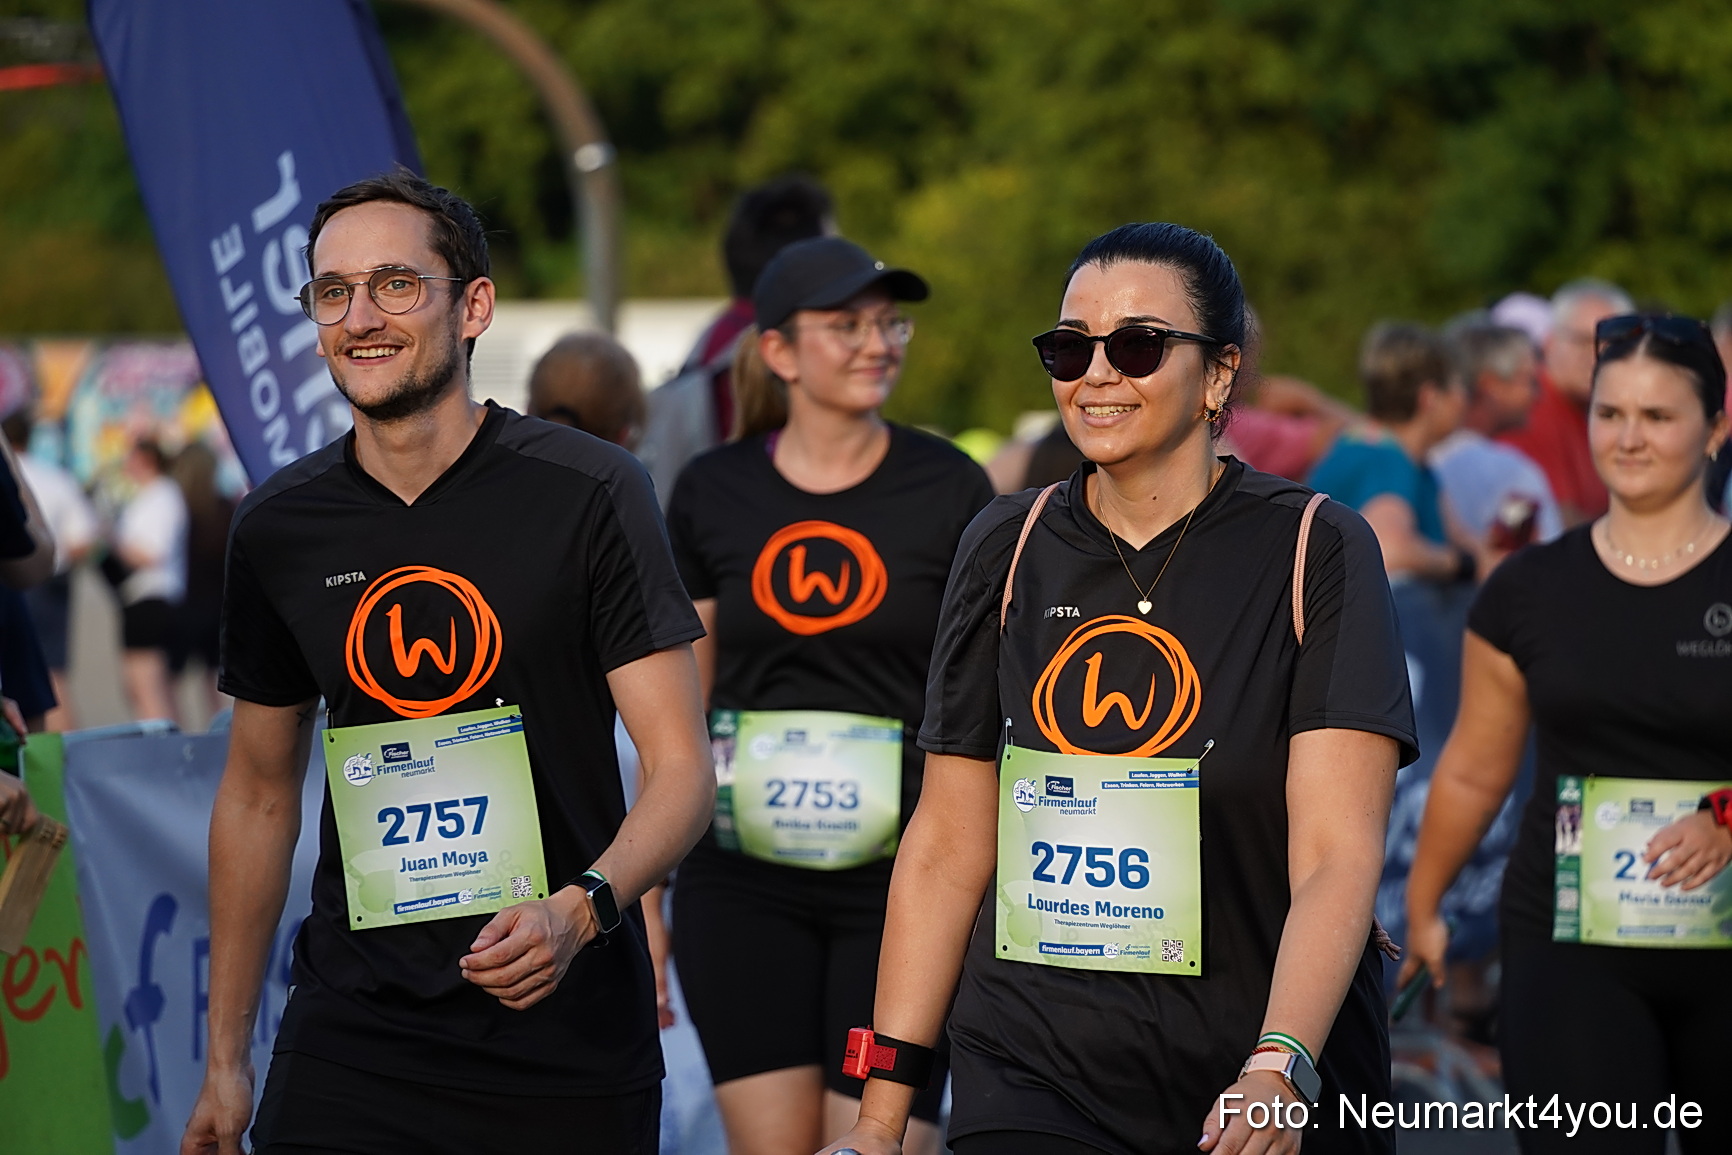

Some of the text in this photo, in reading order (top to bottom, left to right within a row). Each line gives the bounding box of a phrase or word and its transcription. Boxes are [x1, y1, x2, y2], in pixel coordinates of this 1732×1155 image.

[325, 571, 367, 588] KIPSTA
[1043, 606, 1081, 620] KIPSTA
[377, 756, 434, 775] Firmenlauf
[401, 766, 435, 778] neumarkt
[766, 779, 859, 810] 2753
[1038, 796, 1097, 808] Firmenlauf
[377, 796, 489, 847] 2757
[400, 850, 489, 873] Juan Moya
[1031, 841, 1150, 890] 2756
[409, 869, 482, 883] Therapiezentrum Weglöhner
[397, 896, 456, 912] firmenlauf.bayern
[1027, 893, 1165, 920] Lourdes Moreno
[1054, 918, 1131, 930] Therapiezentrum Weglöhner
[1042, 944, 1100, 956] firmenlauf.bayern
